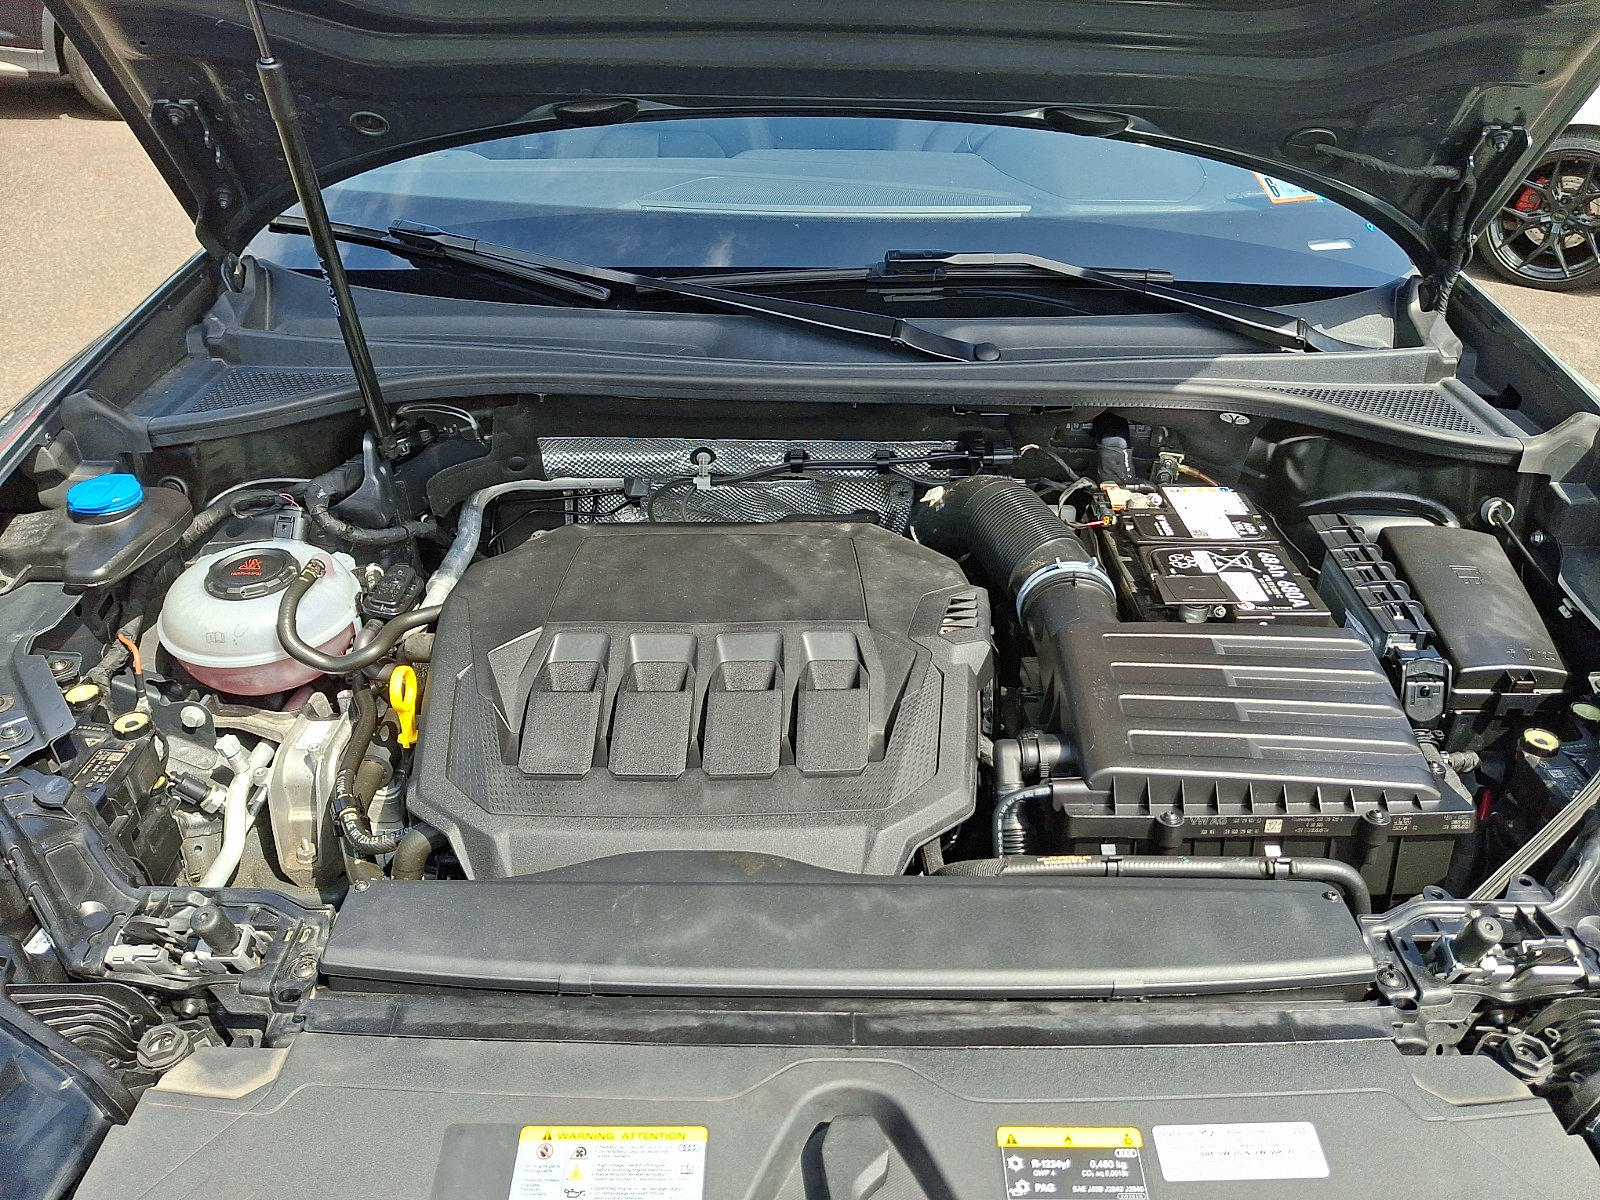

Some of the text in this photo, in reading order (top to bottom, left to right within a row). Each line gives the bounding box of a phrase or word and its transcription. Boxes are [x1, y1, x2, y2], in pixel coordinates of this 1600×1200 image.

[1257, 551, 1288, 578] 68Ah
[1276, 580, 1310, 608] 680A
[1190, 817, 1209, 825] VW
[1209, 817, 1228, 825] AG
[558, 1132, 687, 1140] WARNING ATTENTION
[1115, 1160, 1128, 1170] kg
[1034, 1183, 1057, 1193] PAG
[1072, 1185, 1087, 1193] SAE
